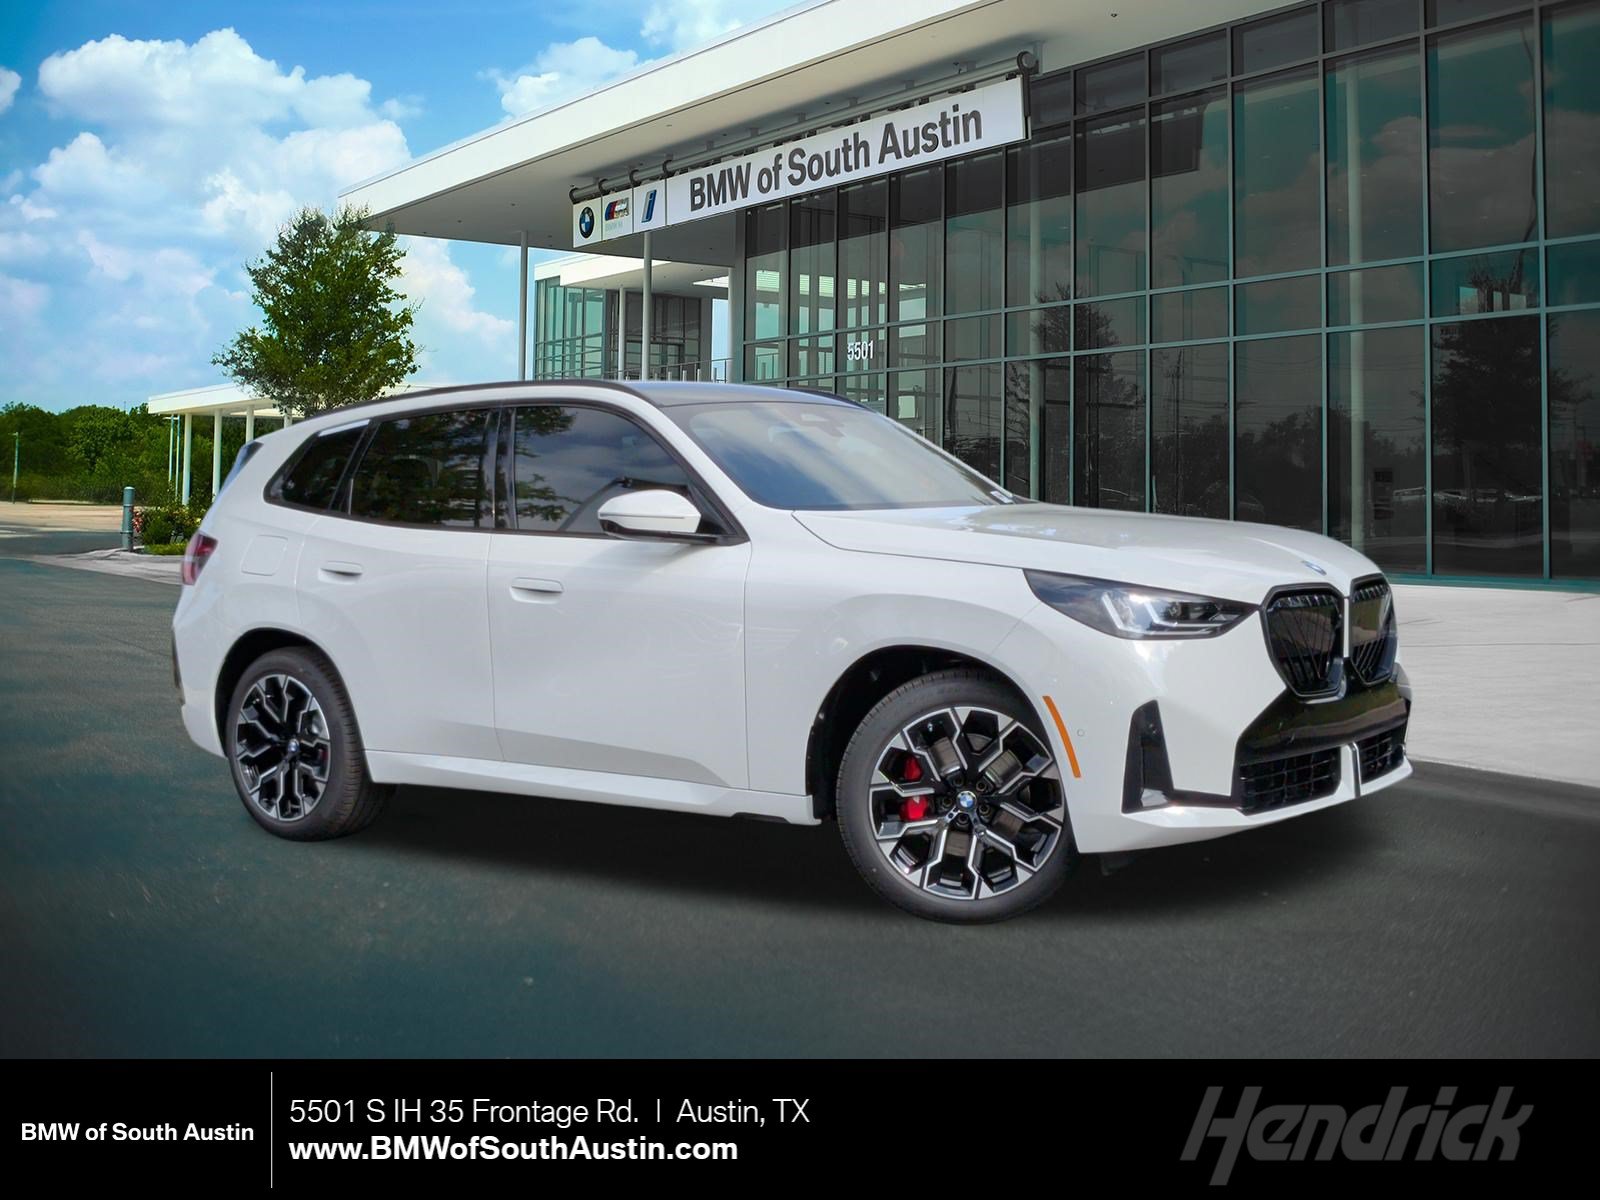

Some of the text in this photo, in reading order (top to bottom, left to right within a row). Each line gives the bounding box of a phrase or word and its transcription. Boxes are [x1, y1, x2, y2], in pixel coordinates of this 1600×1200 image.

[690, 162, 751, 212] BMW
[758, 153, 782, 194] of
[788, 132, 870, 186] South
[878, 104, 982, 164] Austin
[847, 340, 873, 360] 5501
